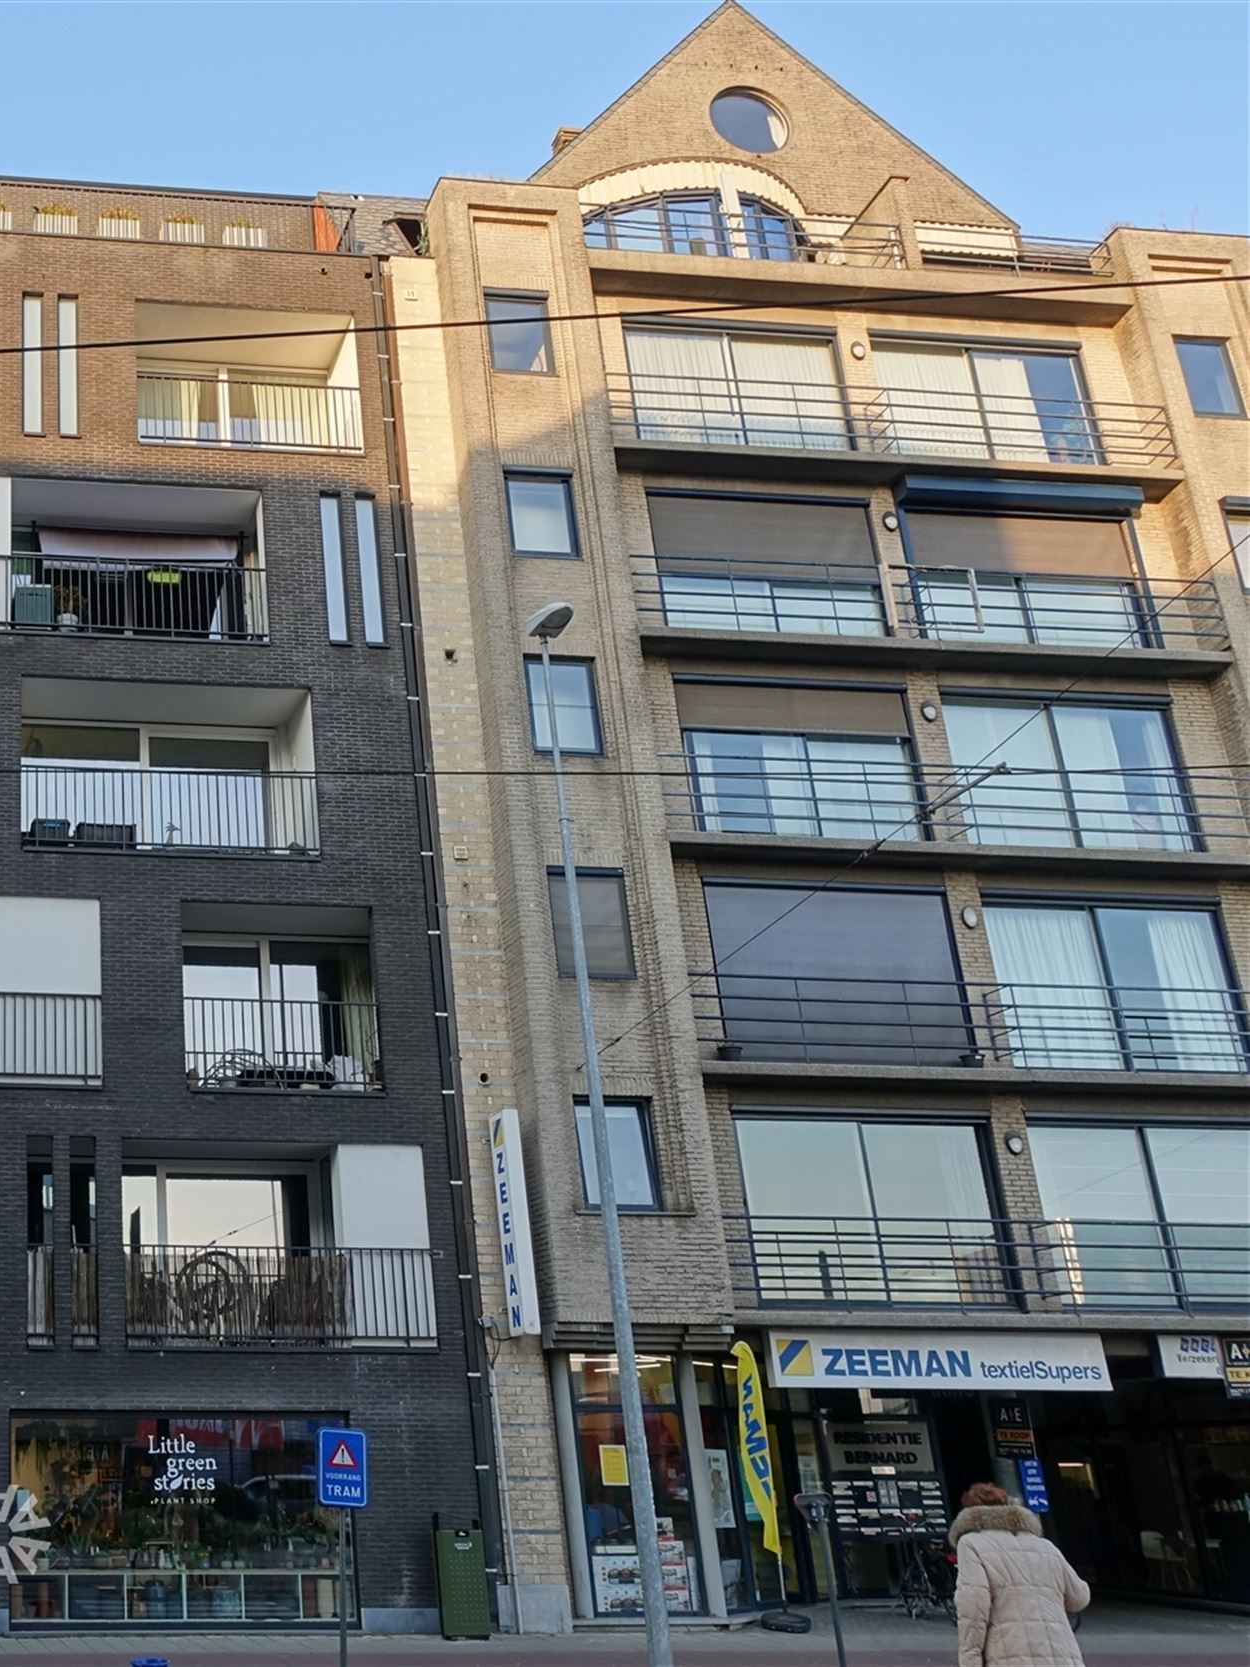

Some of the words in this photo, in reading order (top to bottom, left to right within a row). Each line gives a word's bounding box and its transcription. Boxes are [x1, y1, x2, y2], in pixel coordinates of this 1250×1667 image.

[496, 1151, 522, 1328] ZEEMAN
[821, 1348, 972, 1378] ZEEMAN
[980, 1360, 1102, 1384] textielSupers
[147, 1432, 196, 1454] Little
[833, 1431, 923, 1445] RESIDENTIE
[843, 1450, 918, 1465] BERNARD
[166, 1457, 218, 1478] green
[325, 1471, 362, 1482] VOORRANG
[326, 1484, 362, 1498] TRAM
